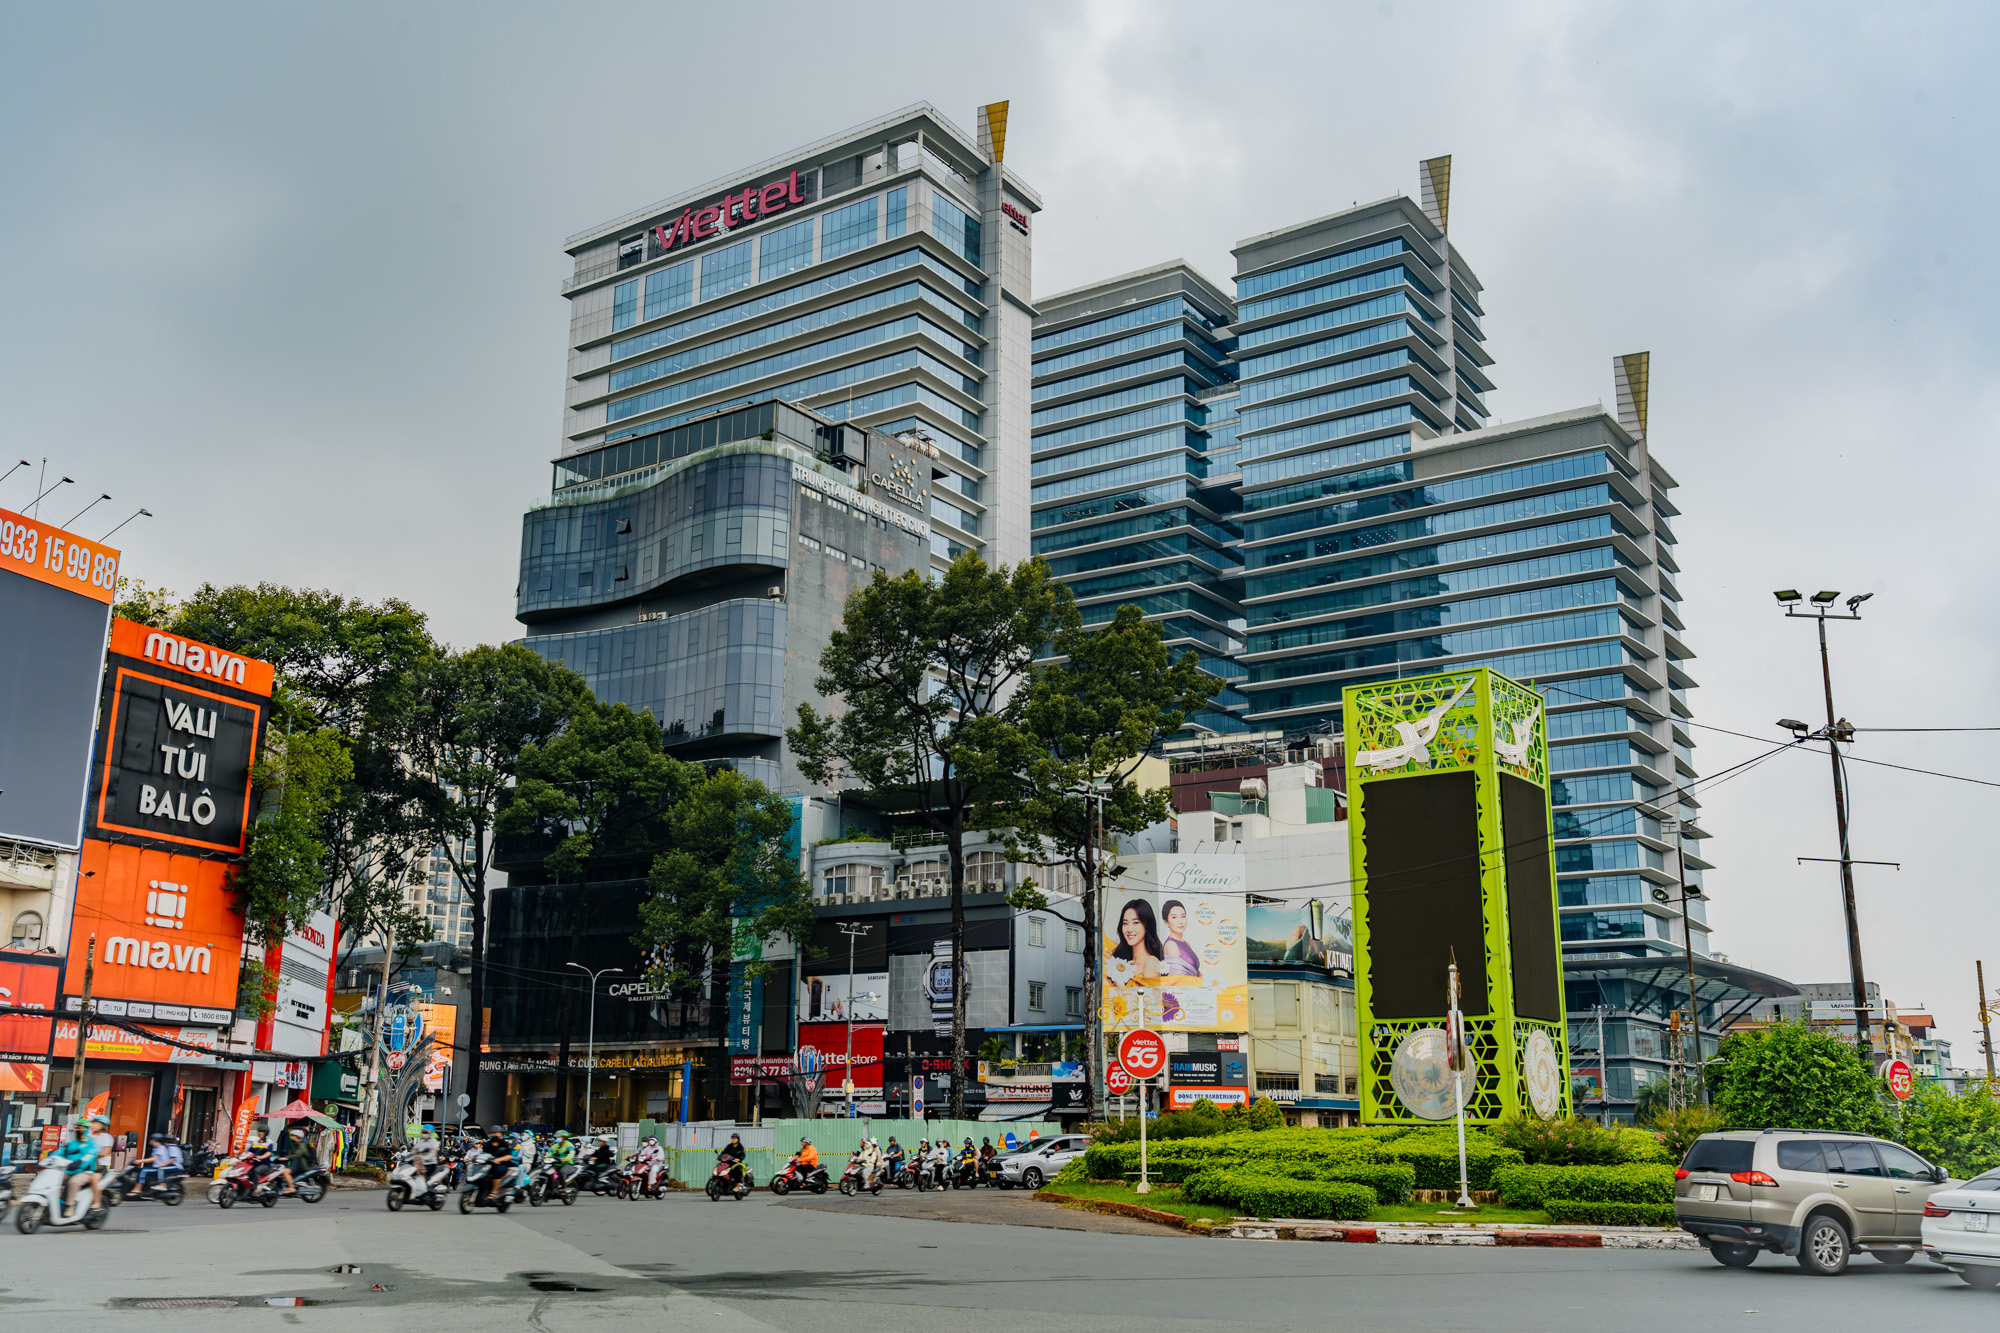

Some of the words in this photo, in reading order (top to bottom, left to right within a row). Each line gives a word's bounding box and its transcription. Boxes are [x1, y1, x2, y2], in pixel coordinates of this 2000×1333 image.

[655, 170, 805, 251] viettel
[1001, 202, 1028, 228] ettel
[795, 467, 828, 492] TRUNG
[829, 481, 849, 501] TÂM
[872, 472, 924, 507] CAPELLA
[888, 492, 911, 506] GALLERY
[911, 503, 924, 513] HALL
[0, 518, 39, 564] 933
[44, 536, 65, 573] 15
[66, 544, 91, 582] 99
[92, 553, 116, 590] 88
[144, 632, 248, 684] mia.vn
[165, 698, 217, 739] VALI
[161, 743, 206, 782] TÚI
[139, 788, 216, 825] BALÔ
[301, 923, 326, 949] HONDA
[104, 935, 211, 974] mia.vn
[1325, 949, 1353, 970] KATINAT
[609, 982, 671, 997] CAPELLA
[1132, 1039, 1158, 1047] viettel
[478, 1061, 501, 1071] RUNG
[922, 1059, 970, 1071] G-SHOK
[1126, 1046, 1158, 1069] 5G
[1173, 1062, 1217, 1072] RAINMUSIC
[769, 1066, 780, 1076] 77
[1109, 1071, 1131, 1088] 5G
[1893, 1074, 1910, 1093] 5G
[1265, 1088, 1303, 1102] KATINAT
[589, 1126, 618, 1134] CAPELL
